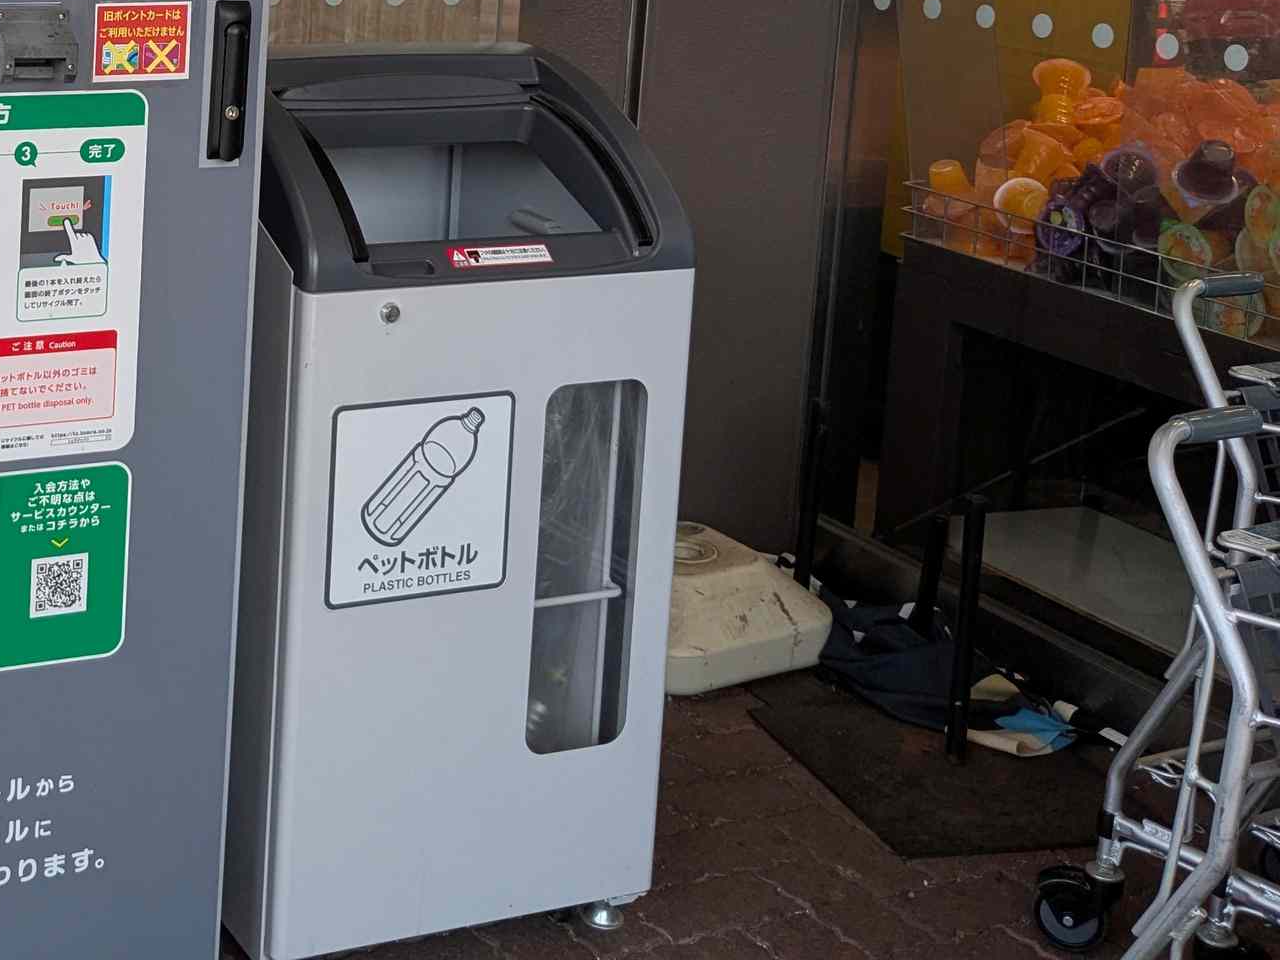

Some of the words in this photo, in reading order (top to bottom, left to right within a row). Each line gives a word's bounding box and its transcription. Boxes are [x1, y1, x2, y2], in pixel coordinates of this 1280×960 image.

[104, 9, 182, 22] 旧ポイントカードは
[99, 26, 185, 39] ご利用いただけません
[21, 146, 31, 161] 3
[88, 144, 116, 159] 完了
[11, 341, 44, 352] ご注意
[49, 340, 76, 349] Caution
[0, 382, 88, 398] 捨てないでください。
[1, 402, 16, 412] PET
[18, 400, 40, 410] bottle
[42, 398, 74, 409] disposal
[33, 479, 91, 495] 入会方法や
[27, 491, 96, 508] ご不明な点は
[10, 504, 112, 522] サービスカウンター
[357, 543, 479, 576] ペットボトル
[363, 577, 414, 594] PLASTIC
[417, 570, 472, 586] BOTTLES
